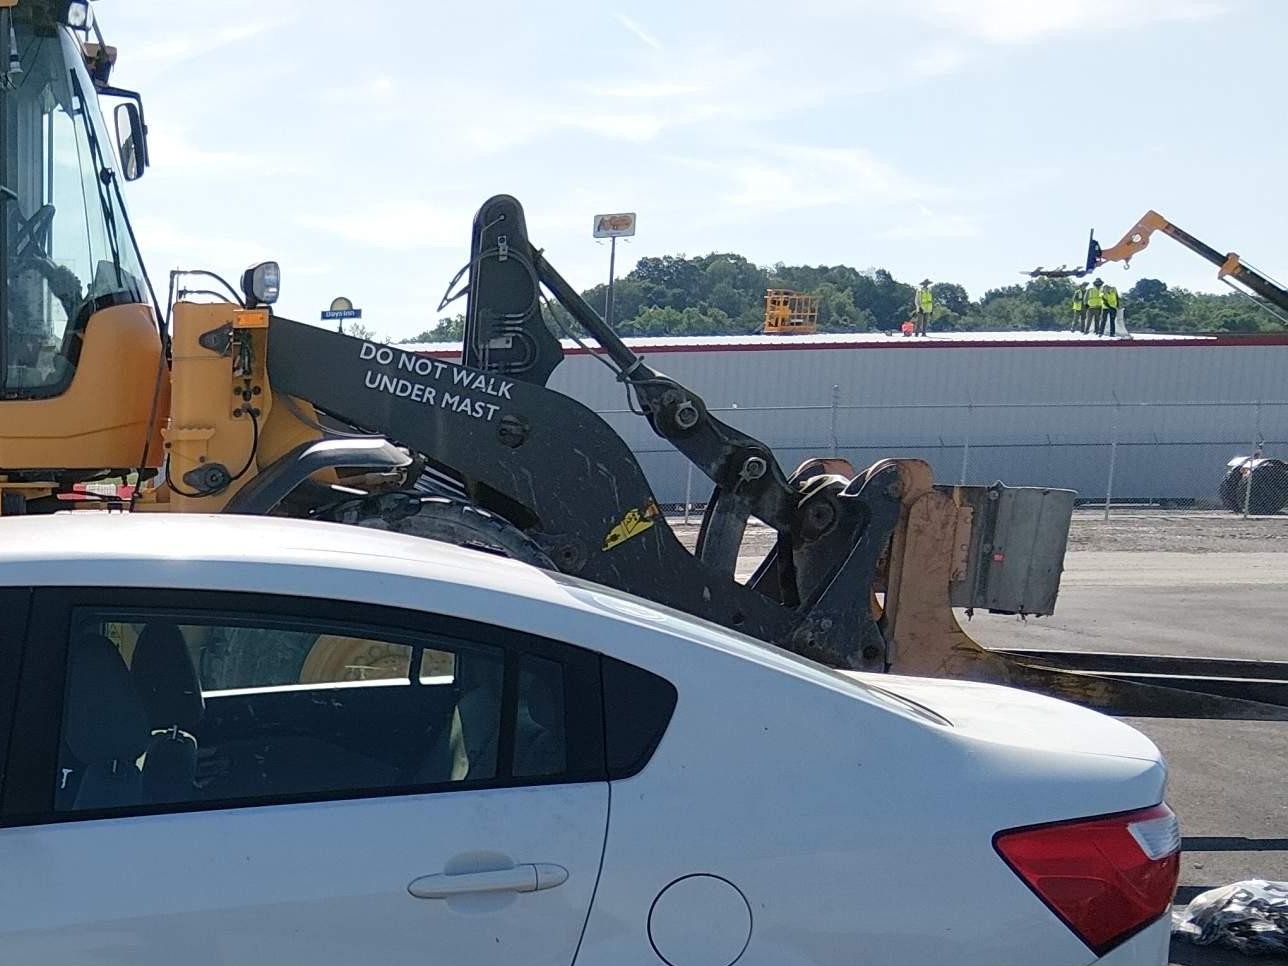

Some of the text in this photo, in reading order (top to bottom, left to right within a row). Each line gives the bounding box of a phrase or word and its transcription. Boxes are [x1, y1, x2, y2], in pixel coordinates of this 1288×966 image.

[360, 343, 514, 400] DO NOT WALK
[365, 371, 500, 421] UNDER MAST
